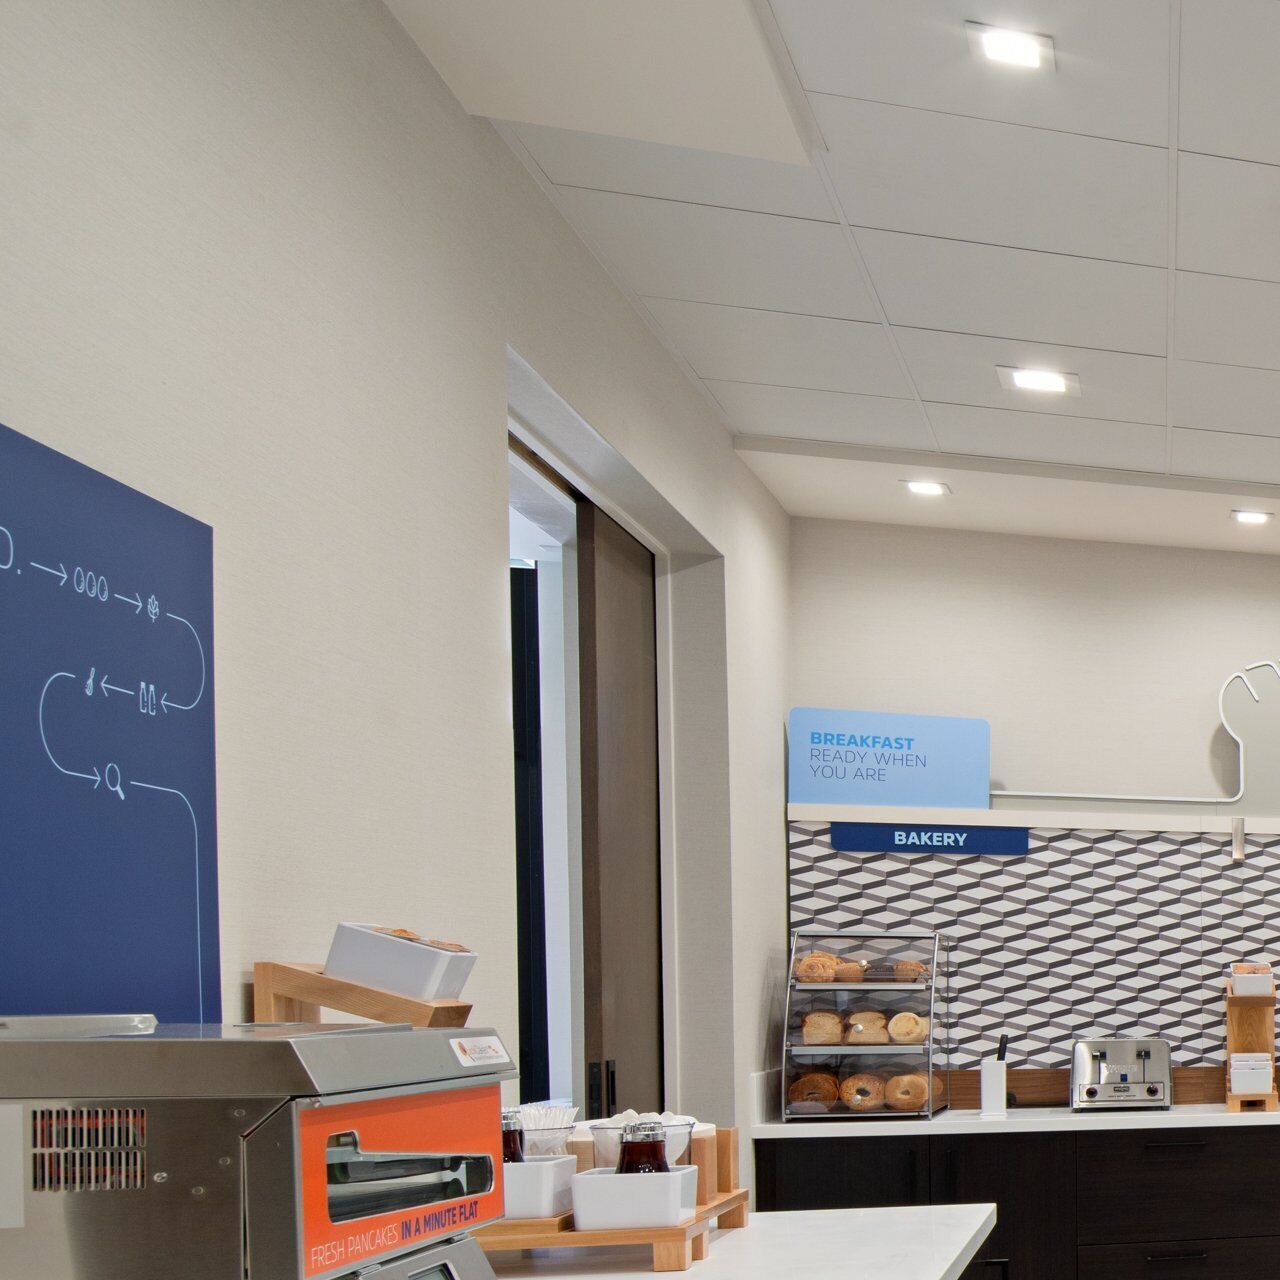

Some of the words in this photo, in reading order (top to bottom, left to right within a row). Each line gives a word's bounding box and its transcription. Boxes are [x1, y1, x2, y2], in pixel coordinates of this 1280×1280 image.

[810, 731, 915, 751] BREAKFAST
[810, 748, 868, 764] READY
[874, 752, 927, 768] WHEN
[809, 764, 846, 780] YOU
[853, 767, 887, 782] ARE
[894, 831, 968, 847] BAKERY
[311, 1239, 345, 1269] FRESH
[348, 1223, 399, 1257] PANCAKES
[401, 1220, 412, 1240] IN
[414, 1217, 421, 1236] A
[424, 1206, 457, 1232] MINUTE
[459, 1200, 478, 1223] FLAT
